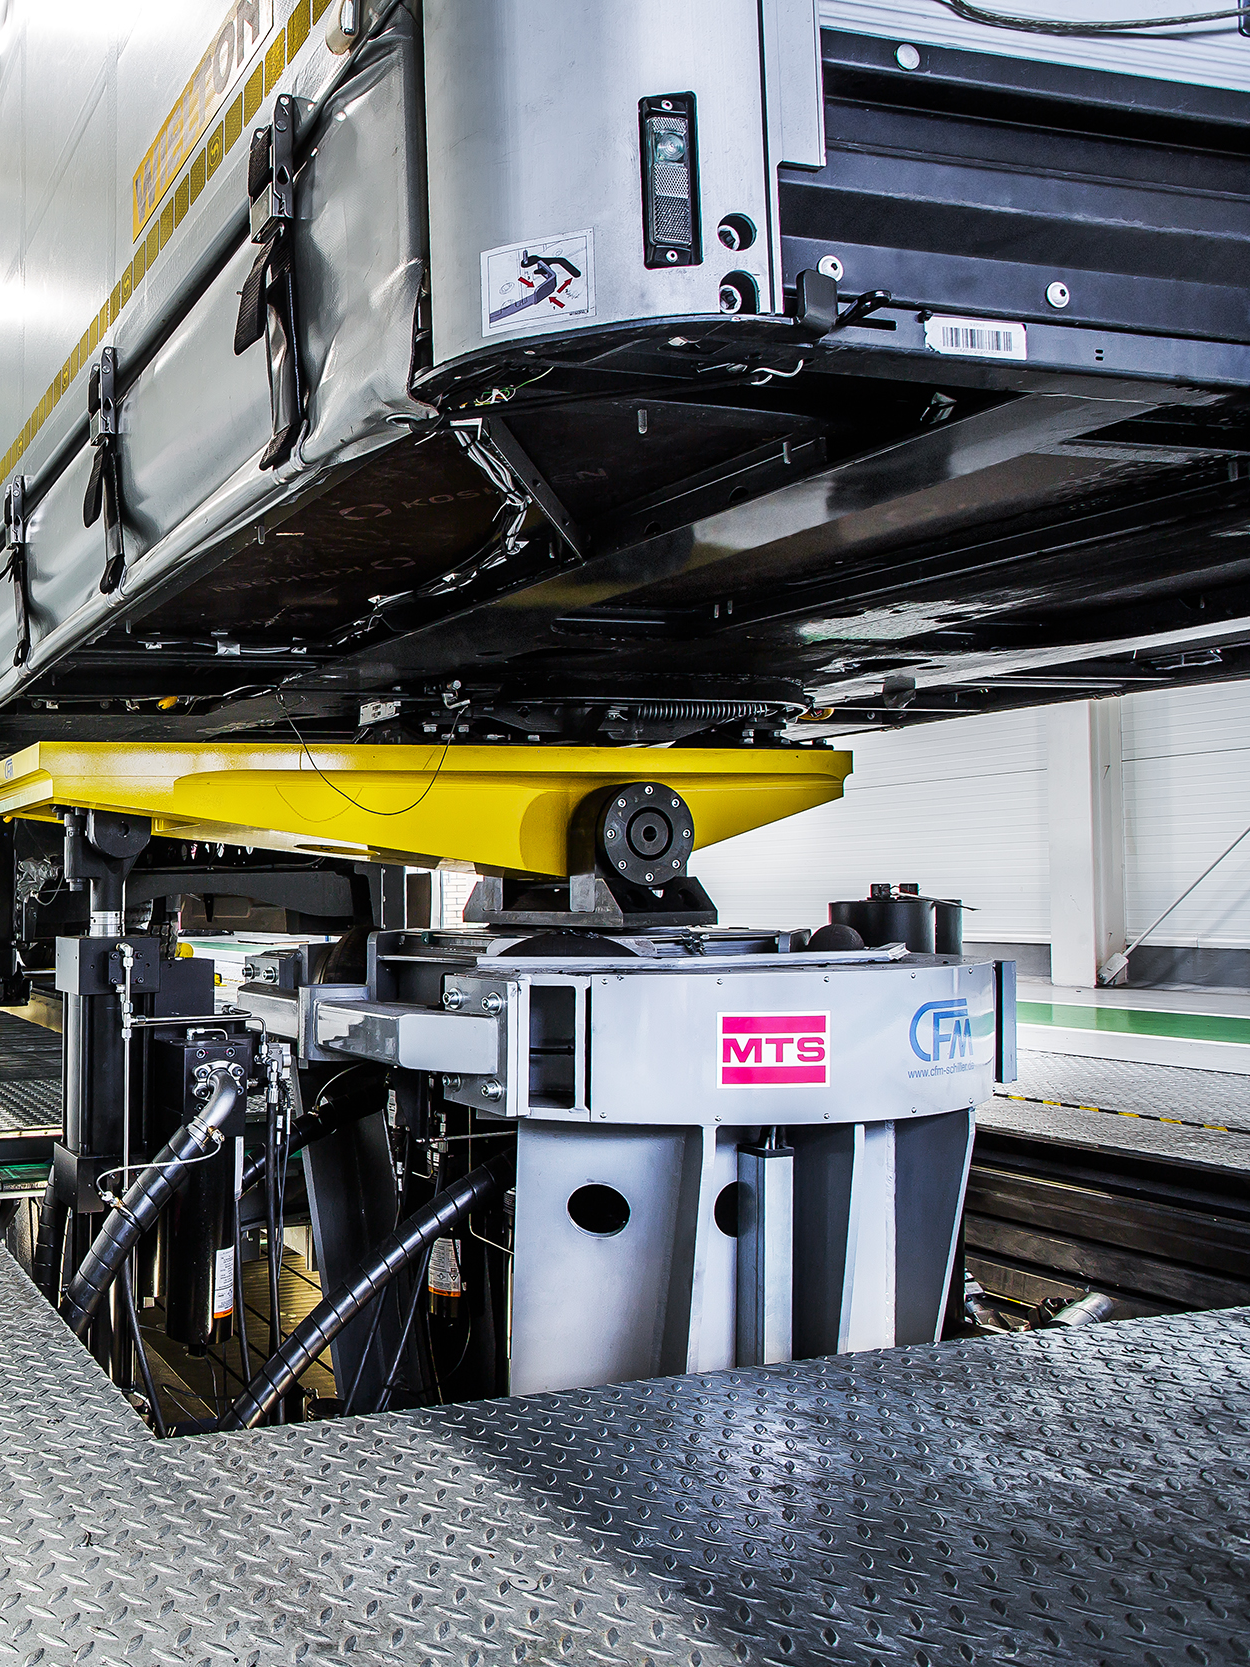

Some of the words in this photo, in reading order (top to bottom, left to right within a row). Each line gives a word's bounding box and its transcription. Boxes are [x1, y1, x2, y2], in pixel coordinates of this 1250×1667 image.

[135, 0, 260, 224] WIELTON
[722, 1037, 826, 1063] MTS
[909, 997, 974, 1062] CFM
[907, 1062, 975, 1079] www.cfm-schiller.de
